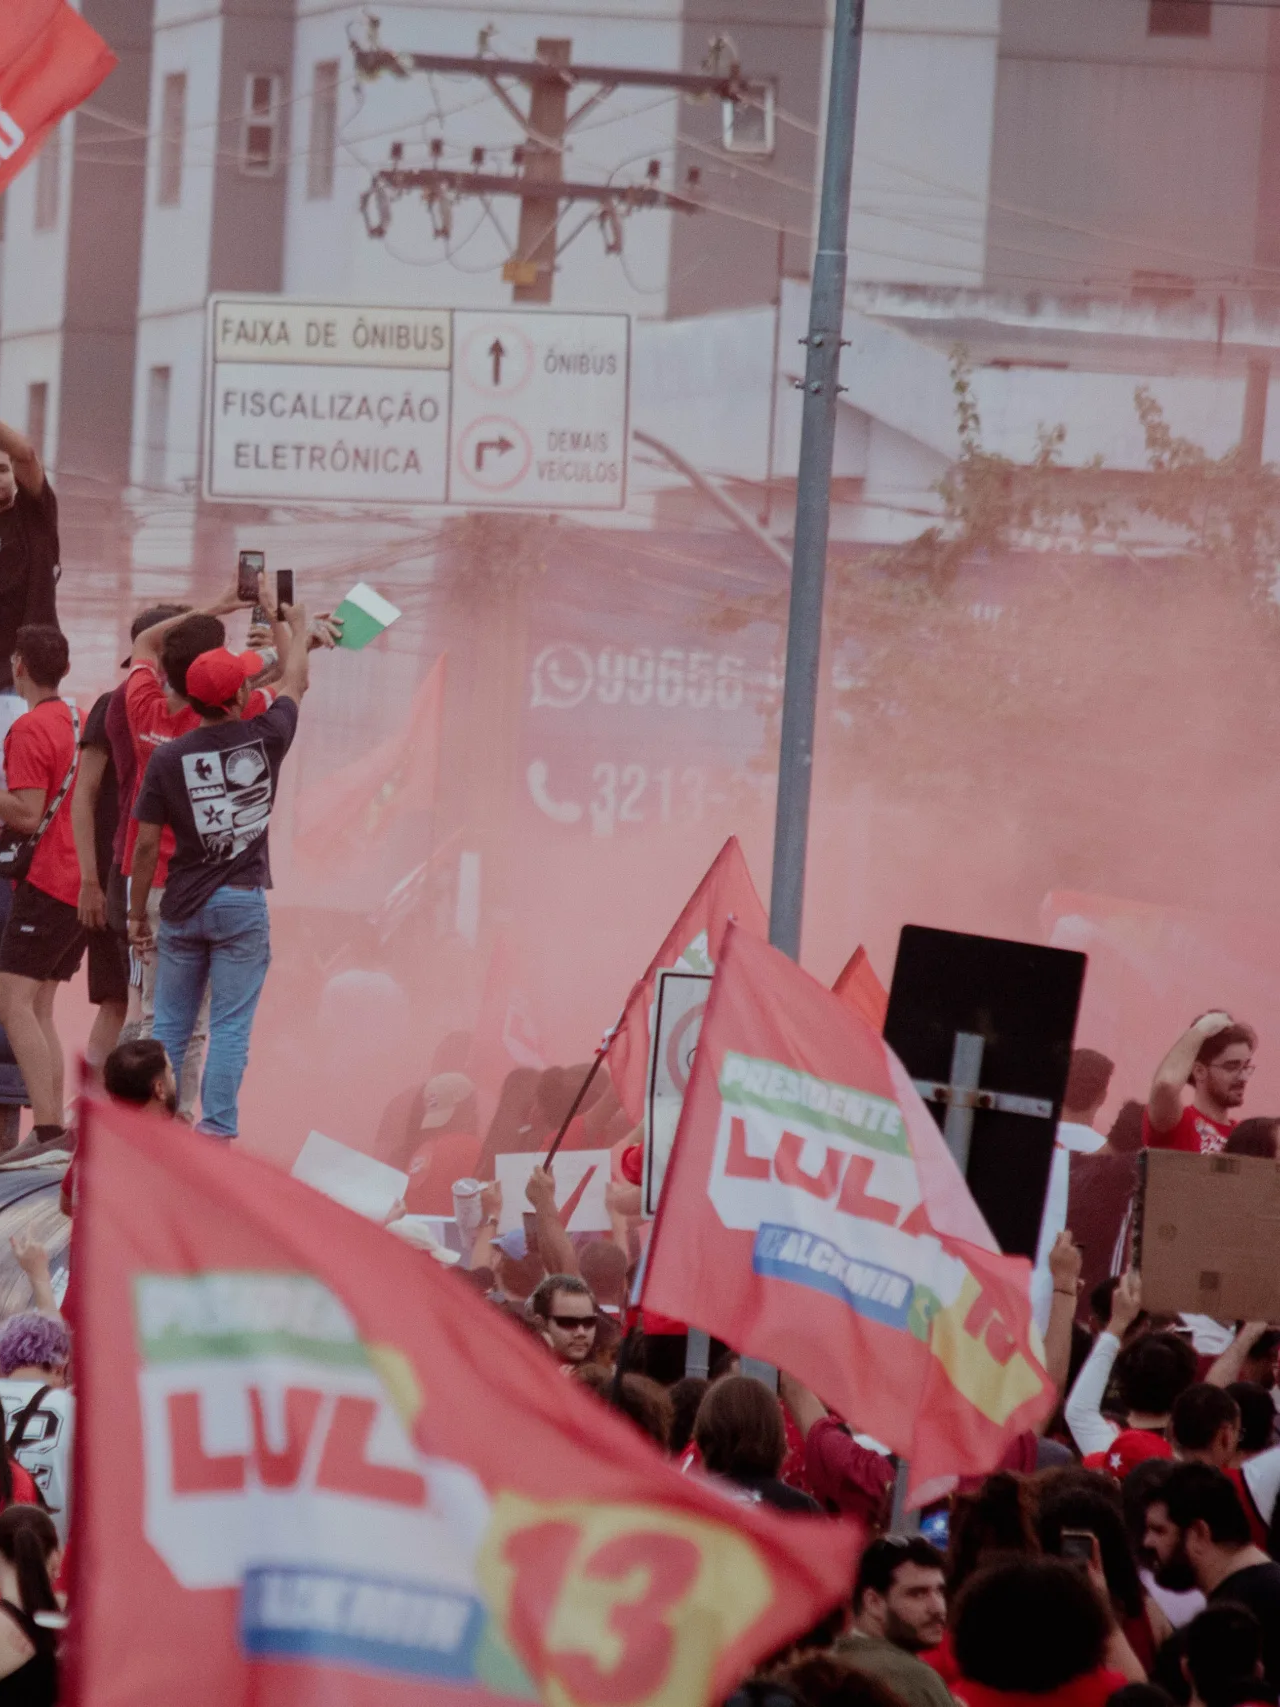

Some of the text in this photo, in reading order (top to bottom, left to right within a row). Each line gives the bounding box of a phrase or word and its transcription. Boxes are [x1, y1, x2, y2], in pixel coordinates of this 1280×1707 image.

[221, 315, 445, 351] FAIXA DE ÔNIBUS
[543, 348, 618, 376] ÔNIBUS
[222, 389, 440, 427] FISCALIZAÇÃO
[234, 439, 423, 475] ELETRÔNICA
[547, 429, 609, 453] DEMAIS
[536, 456, 619, 483] VEÍCULOS
[723, 1057, 903, 1137] PRESIDENTE
[503, 1519, 704, 1702] 13
